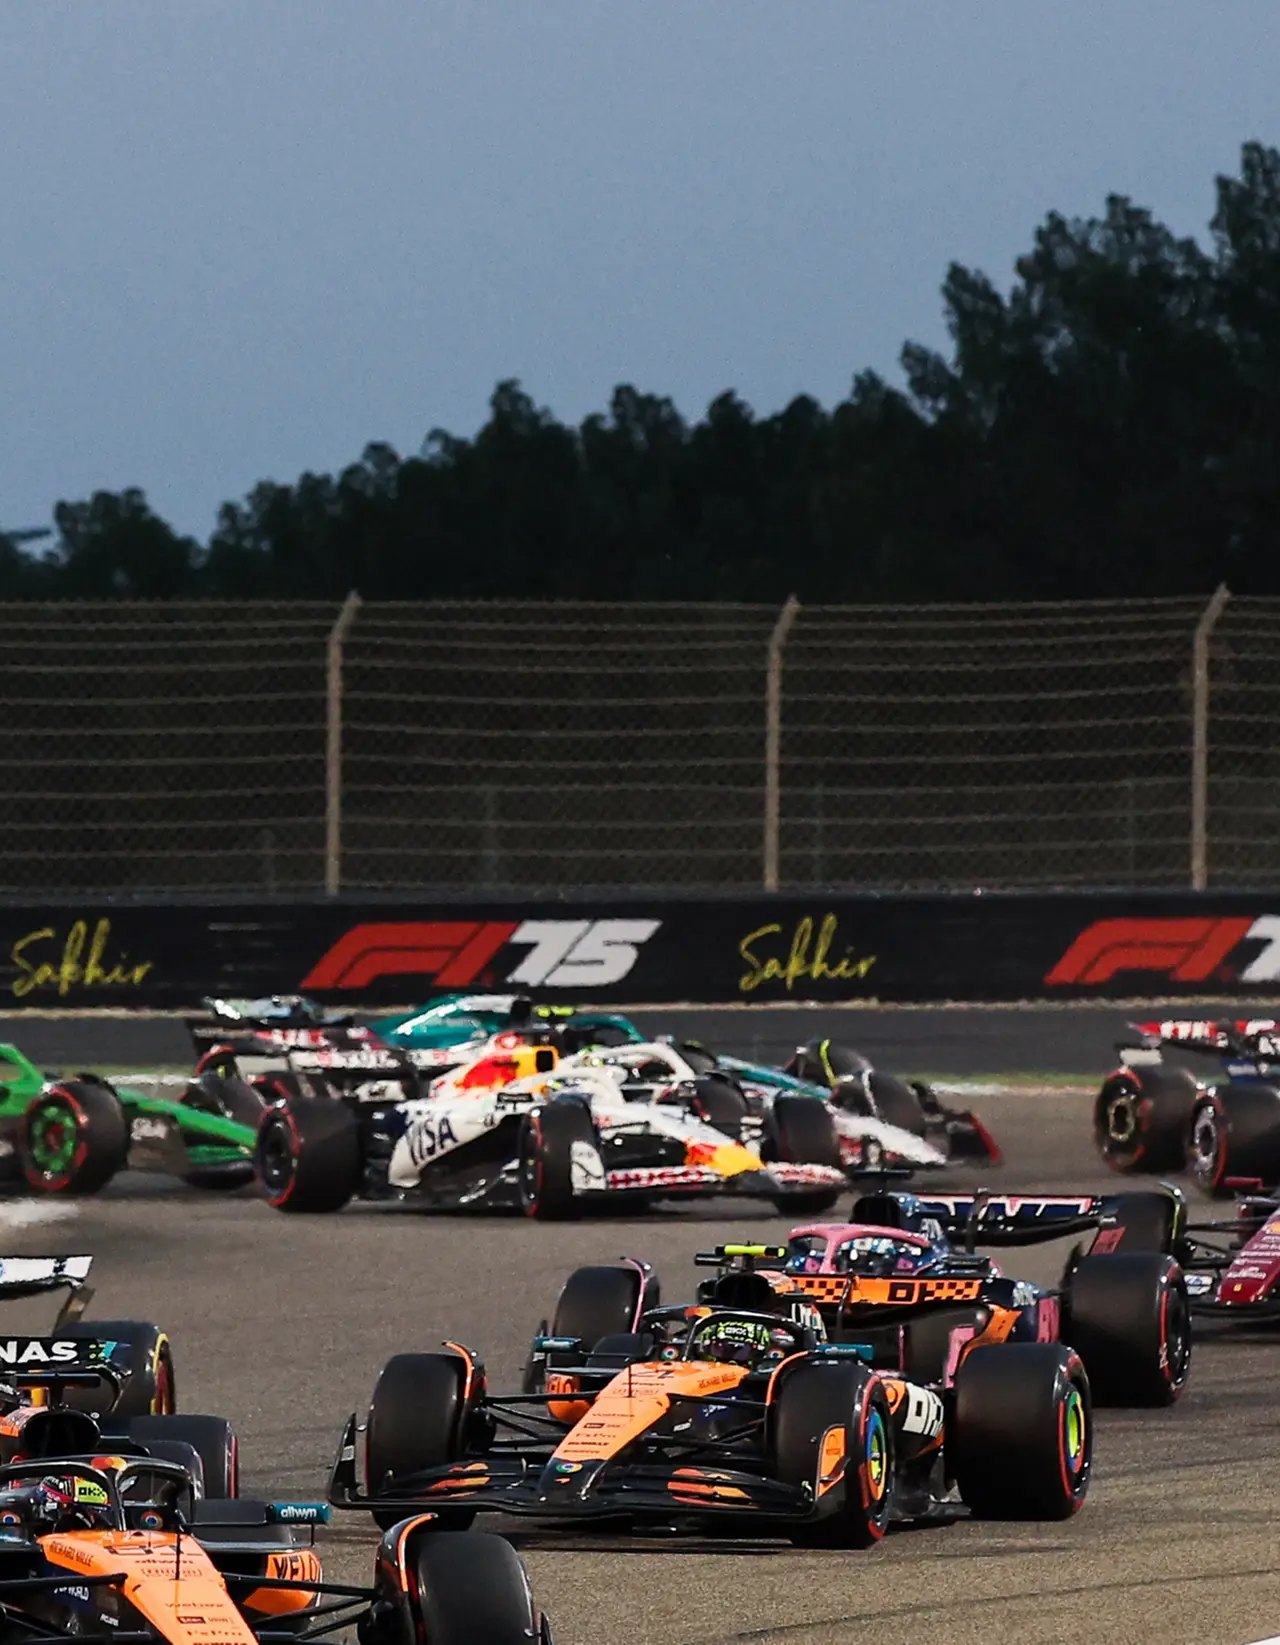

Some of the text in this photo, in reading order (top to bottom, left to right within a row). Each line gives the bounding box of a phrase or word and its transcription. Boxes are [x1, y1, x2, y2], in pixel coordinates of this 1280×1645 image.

[11, 919, 151, 996] Sakhir
[300, 919, 661, 988] F1 75
[738, 914, 877, 991] Sakhir
[1044, 917, 1253, 985] F1
[405, 1116, 459, 1167] VISA
[78, 1486, 105, 1497] OKX
[280, 1505, 318, 1520] allwyn
